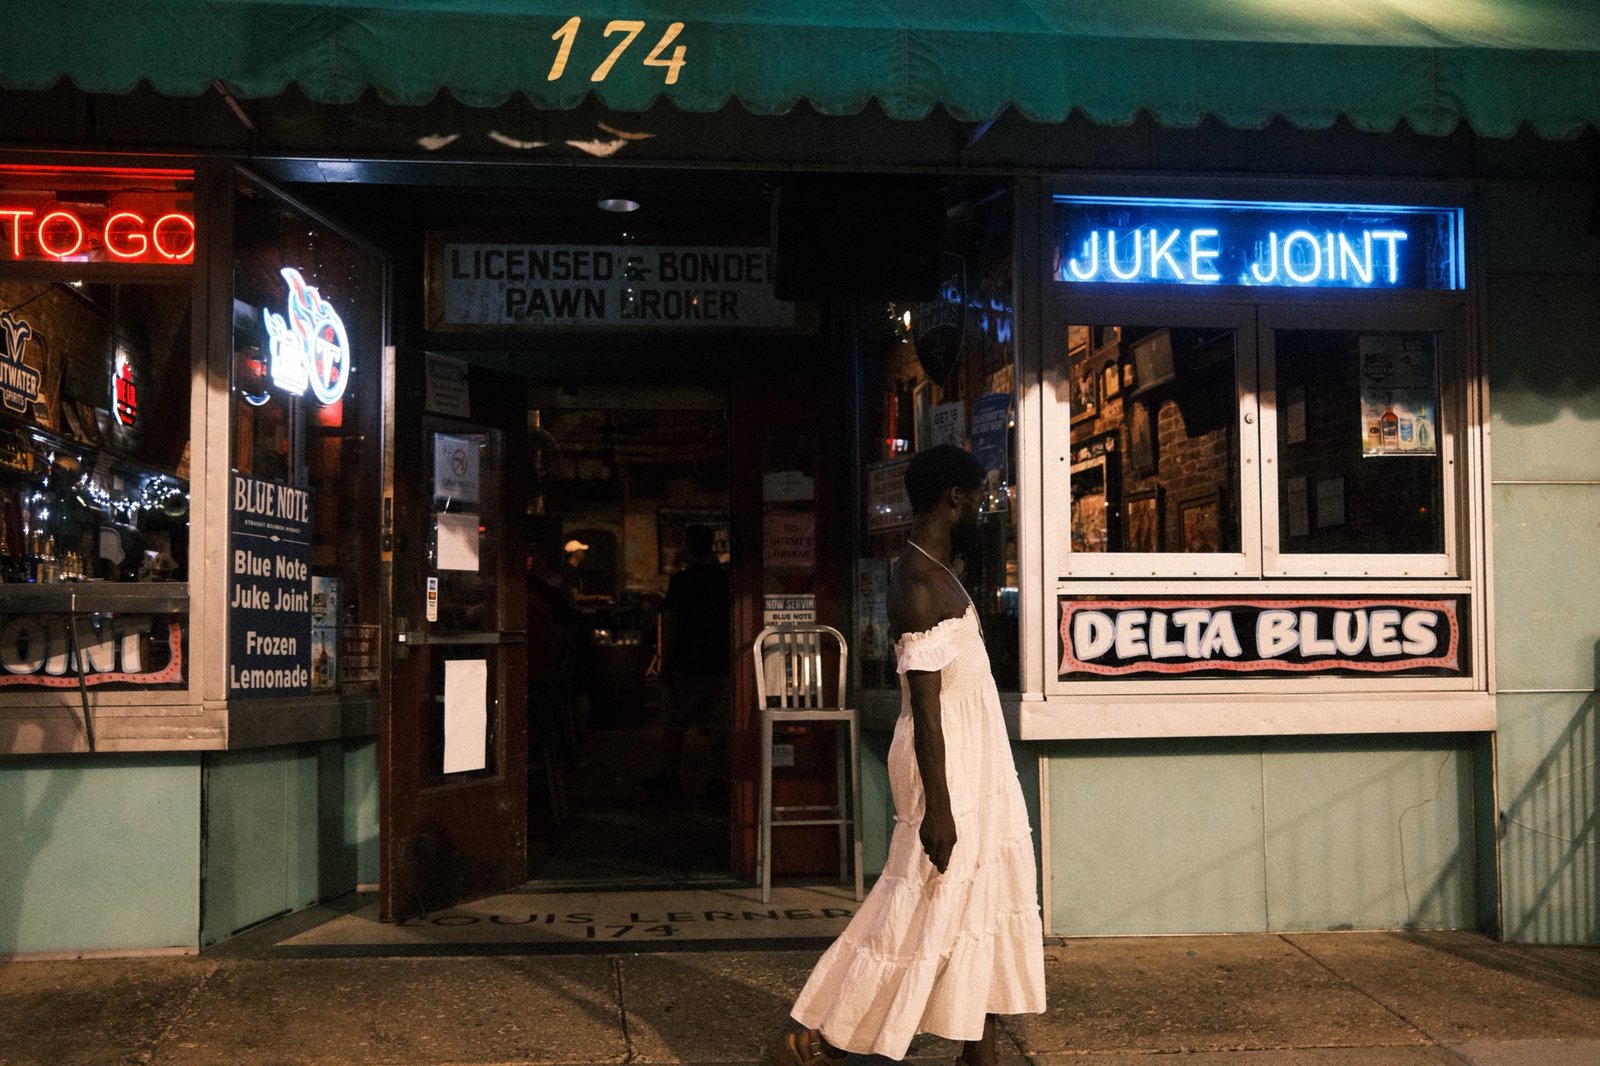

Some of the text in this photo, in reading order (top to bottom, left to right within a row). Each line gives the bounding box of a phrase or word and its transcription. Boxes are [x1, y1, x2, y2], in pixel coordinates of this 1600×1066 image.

[547, 16, 687, 85] 174
[0, 210, 194, 260] TO GO
[451, 249, 614, 281] LICENSED
[659, 252, 778, 283] BONDE
[1068, 227, 1409, 285] JUKE JOINT
[505, 288, 740, 320] PAWN BROKER
[234, 476, 310, 524] BLUE NOTE
[234, 549, 308, 582] Blue Note
[231, 583, 271, 611] Juke
[274, 587, 309, 613] Joint
[246, 630, 298, 656] Frozen
[1074, 608, 1439, 661] DELTA BLUES
[230, 664, 308, 690] Lemonade
[586, 924, 679, 938] 174
[629, 908, 856, 923] LERNER
